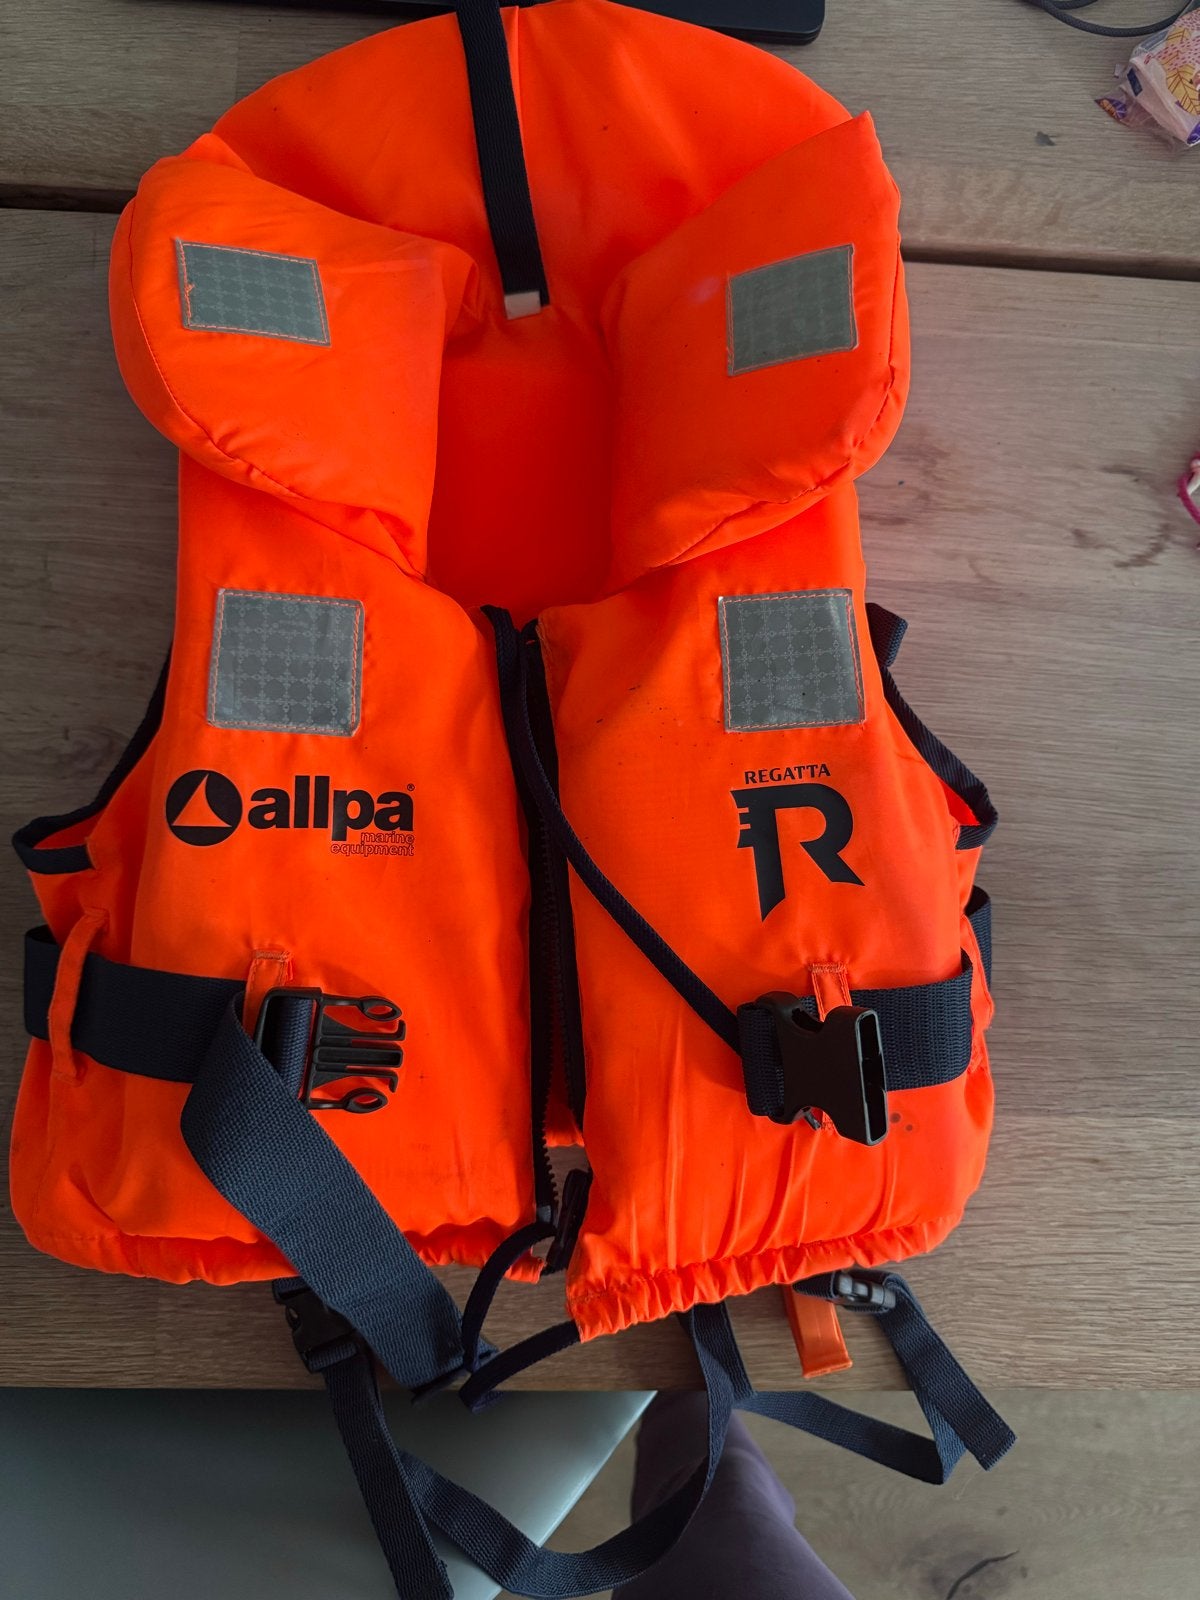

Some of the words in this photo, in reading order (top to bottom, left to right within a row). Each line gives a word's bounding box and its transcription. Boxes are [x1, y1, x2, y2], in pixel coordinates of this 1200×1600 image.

[744, 763, 831, 784] REGATTA
[361, 831, 415, 844] marine
[331, 842, 415, 857] equipment
